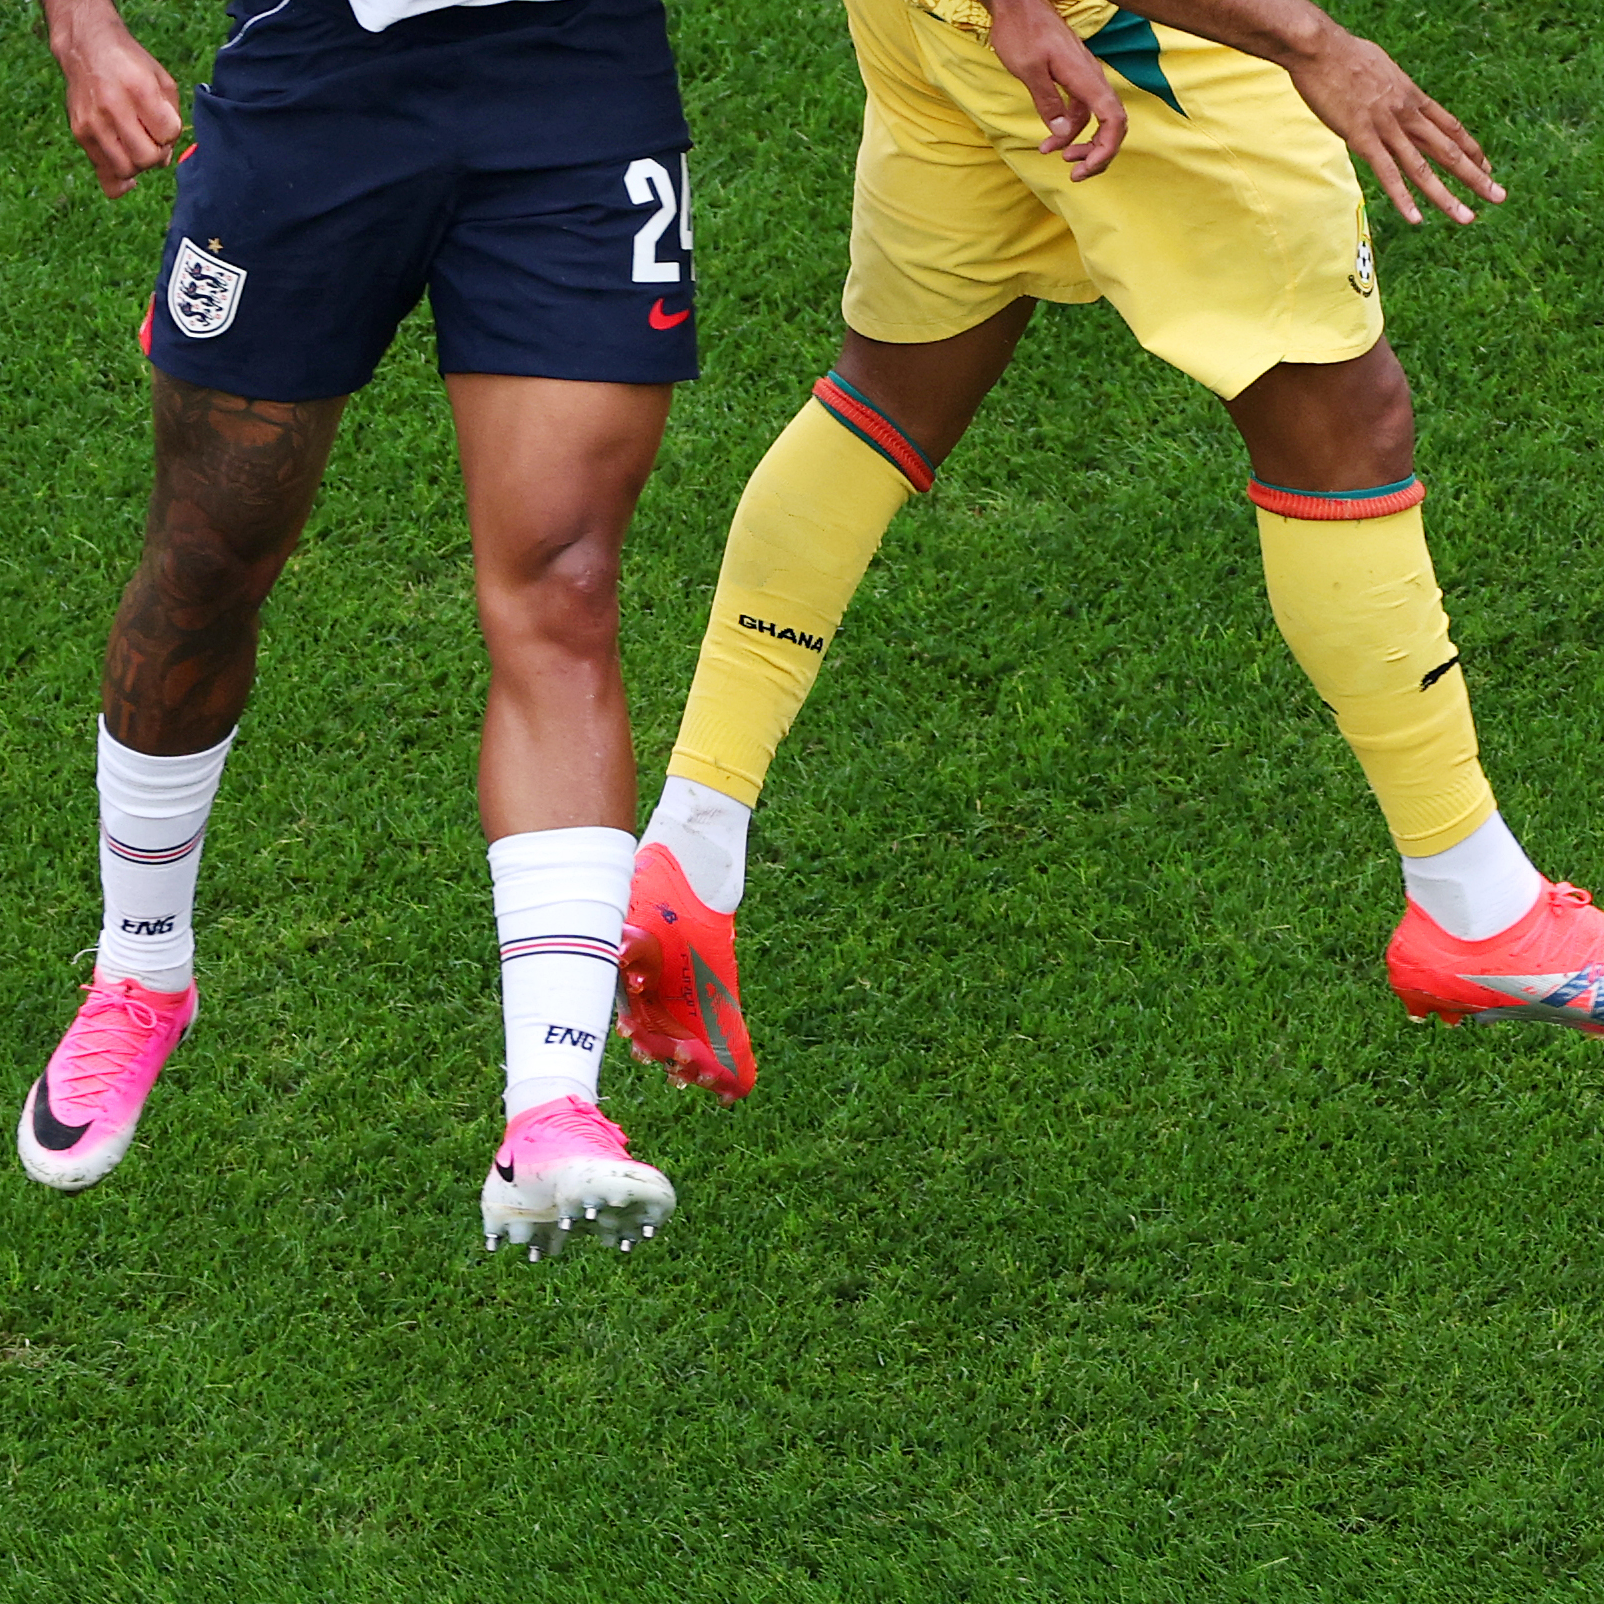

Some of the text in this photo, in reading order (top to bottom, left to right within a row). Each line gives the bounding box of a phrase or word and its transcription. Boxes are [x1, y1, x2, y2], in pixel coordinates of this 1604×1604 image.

[738, 614, 824, 654] GHANA
[121, 914, 176, 935] ENG
[544, 1024, 597, 1052] ENG
